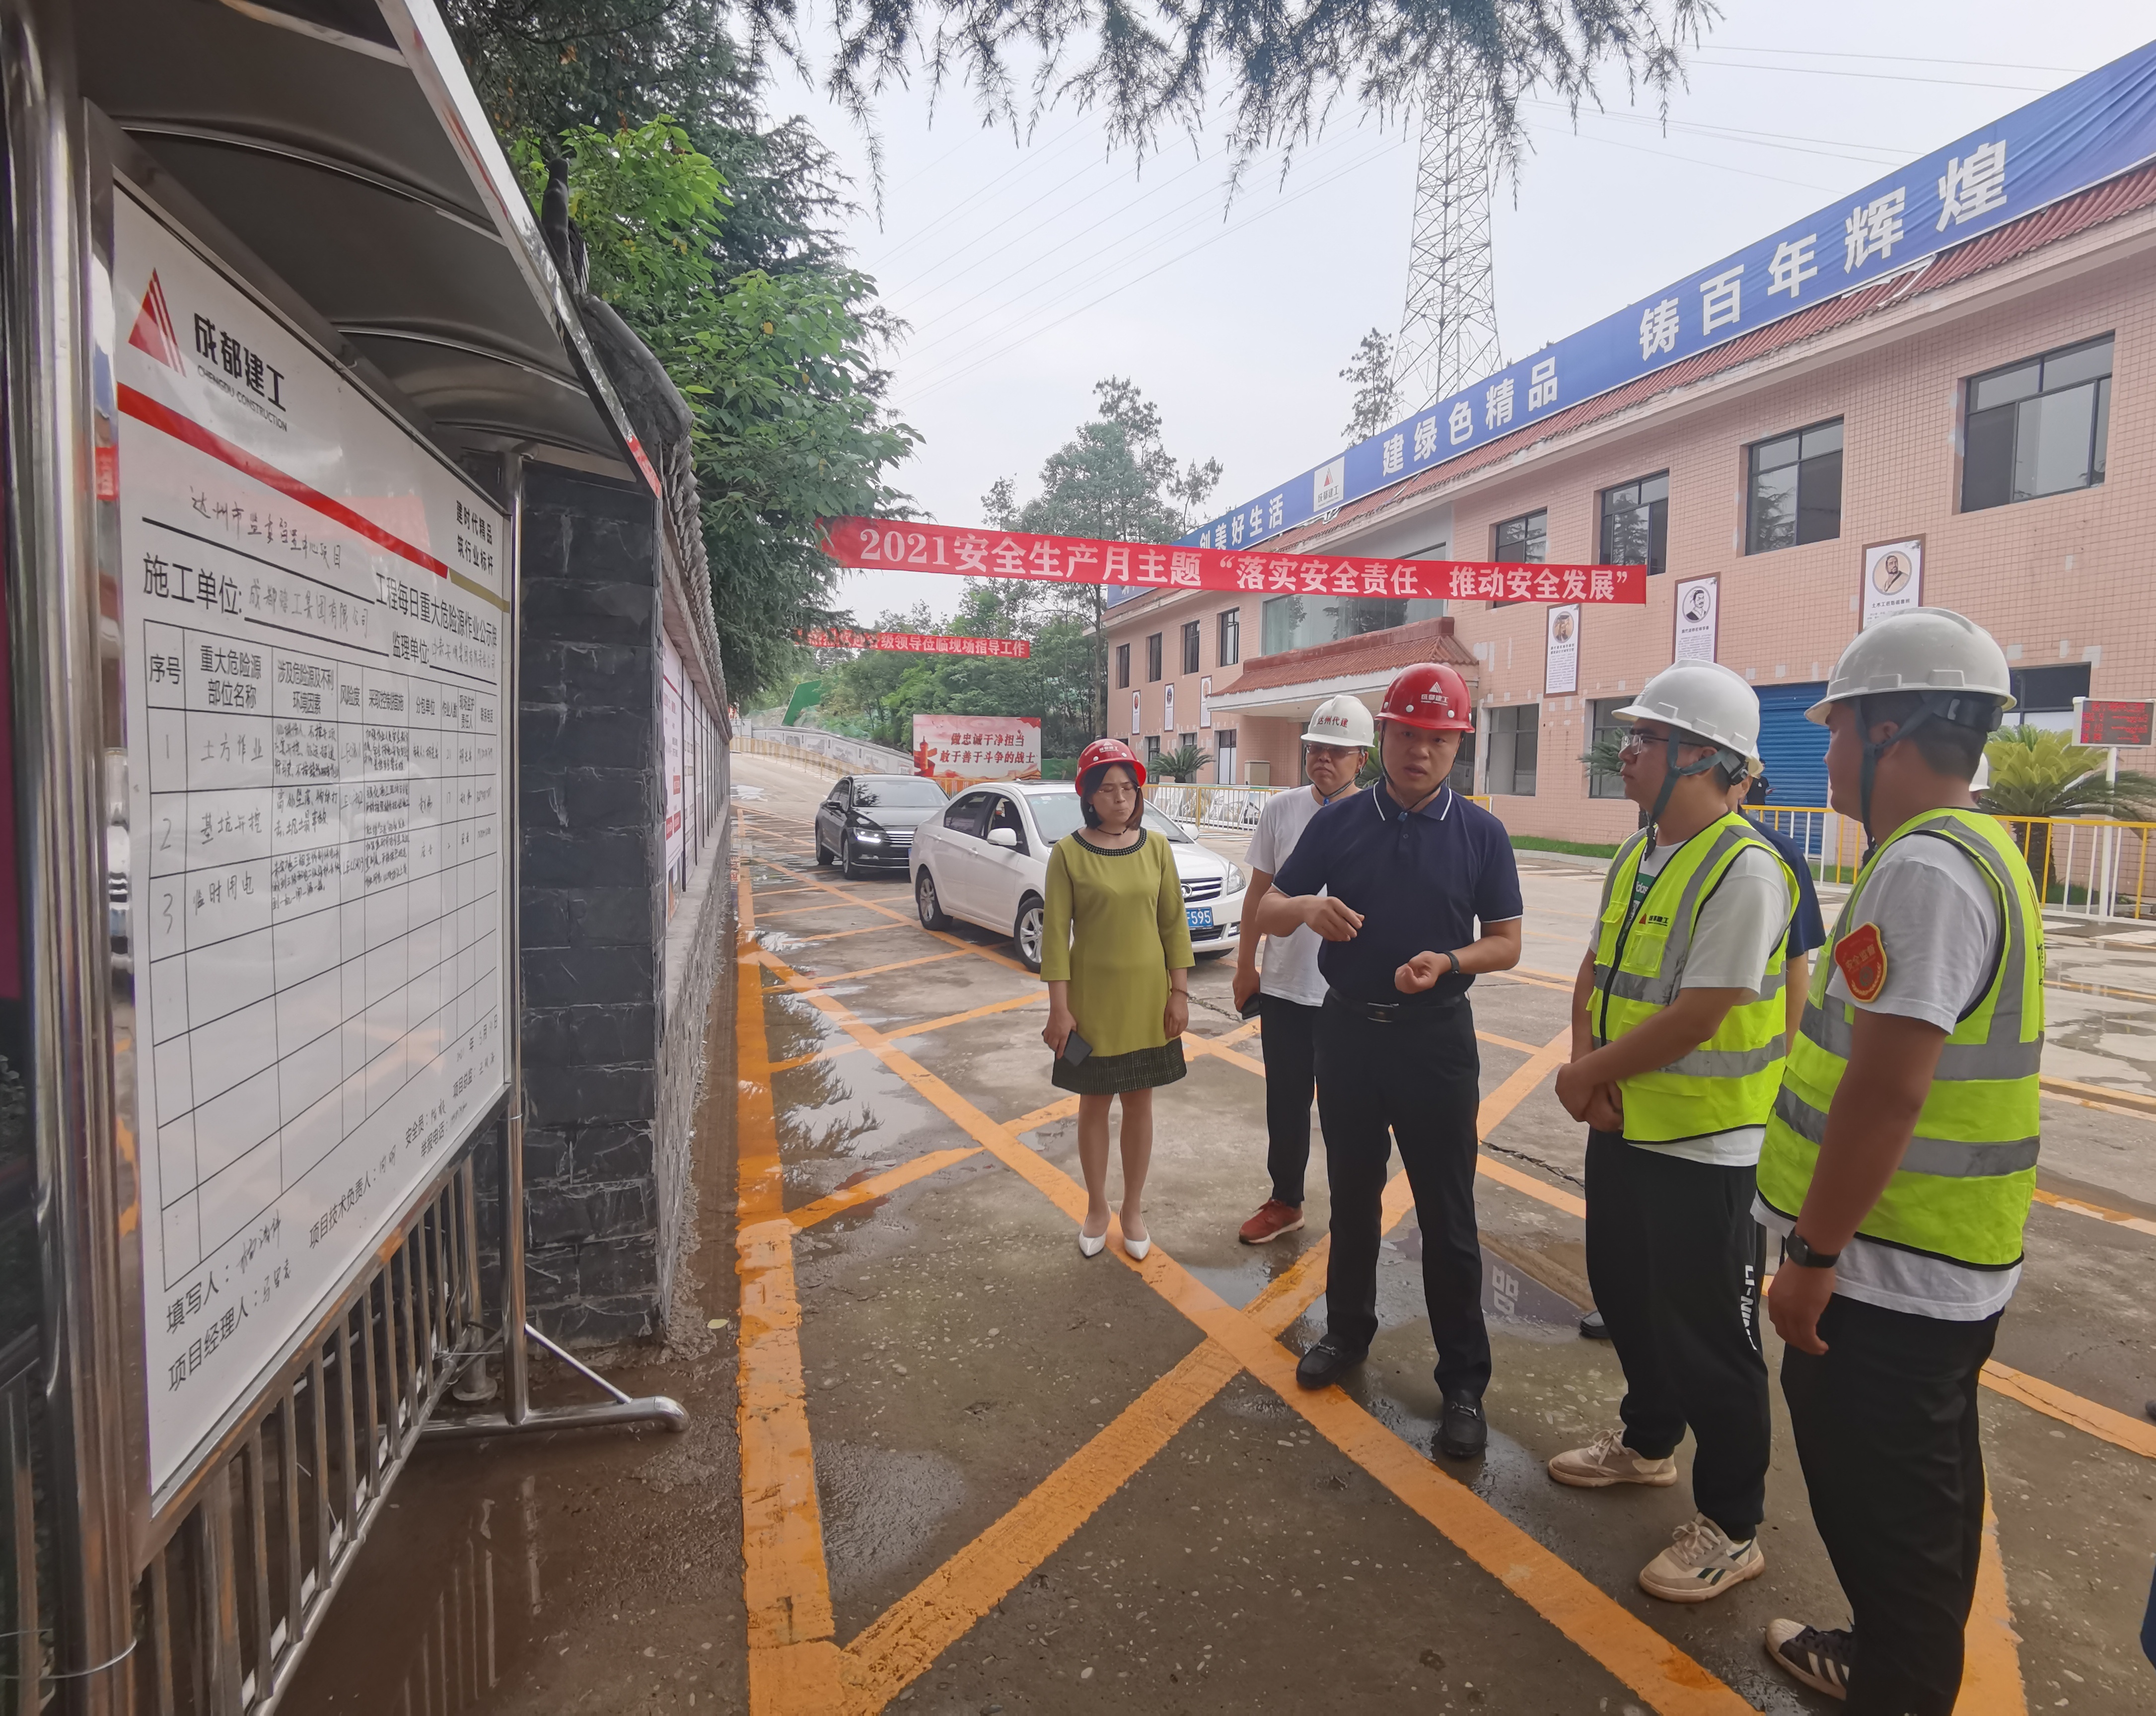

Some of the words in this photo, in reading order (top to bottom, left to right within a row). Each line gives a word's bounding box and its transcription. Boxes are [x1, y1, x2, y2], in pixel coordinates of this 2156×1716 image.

[1382, 357, 1558, 477] 建绿色精品
[1639, 139, 2007, 361] 铸百年辉煌
[194, 312, 286, 412] 成都建工
[197, 364, 235, 398] CHENGDU
[236, 390, 287, 432] CONSTRUCTION
[456, 500, 493, 545] 建时代精品
[457, 533, 494, 576] 筑行业标杆
[860, 528, 1202, 587] 2021安全生产月主题
[149, 654, 181, 685] 序号
[200, 645, 261, 679] 重大危险源
[208, 678, 256, 709] 部位名称
[201, 732, 263, 764] 土方作业
[940, 750, 1035, 763] 敢于善于斗争的战士
[951, 732, 1024, 747] 做忠诚干净担当
[160, 818, 171, 851] 2
[201, 807, 262, 845] 基坑开挖
[163, 893, 173, 934] 3
